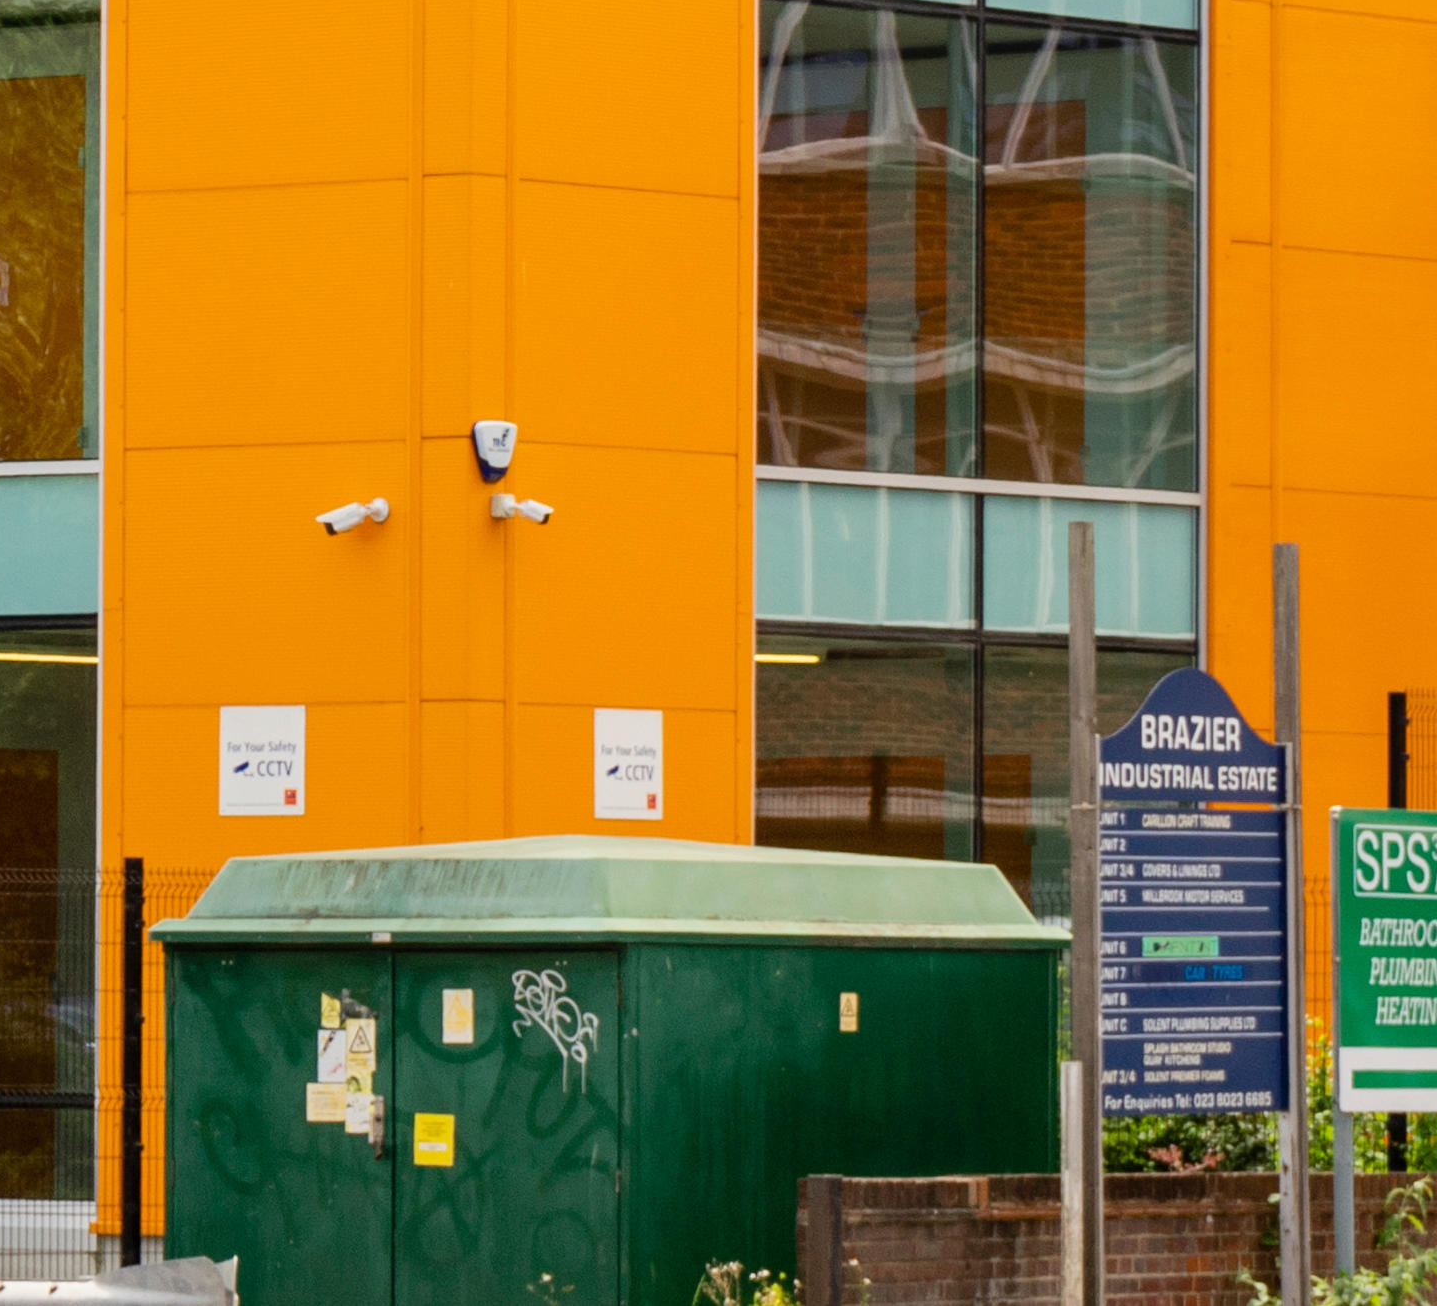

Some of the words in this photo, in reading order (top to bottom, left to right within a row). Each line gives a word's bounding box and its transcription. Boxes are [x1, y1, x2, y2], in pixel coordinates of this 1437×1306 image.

[1141, 714, 1241, 752] BRAZIER
[227, 742, 241, 752] For
[245, 742, 265, 752] Your
[268, 741, 296, 754] Safety
[601, 745, 613, 755] For
[615, 746, 632, 756] Your
[634, 745, 656, 759] Safety
[256, 760, 293, 777] CCTV
[625, 765, 654, 781] CCTV
[1099, 762, 1214, 789] INDUSTRIAL
[1218, 765, 1278, 792] ESTATE
[1119, 838, 1126, 852] 2
[1356, 830, 1430, 892] SPS
[1119, 966, 1126, 980] 7
[1184, 966, 1207, 981] CAR
[1213, 965, 1244, 980] TYRES
[1243, 1017, 1256, 1030] LTD
[1104, 1095, 1122, 1110] For
[1124, 1094, 1173, 1112] Enquiries
[1193, 1093, 1215, 1108] 023
